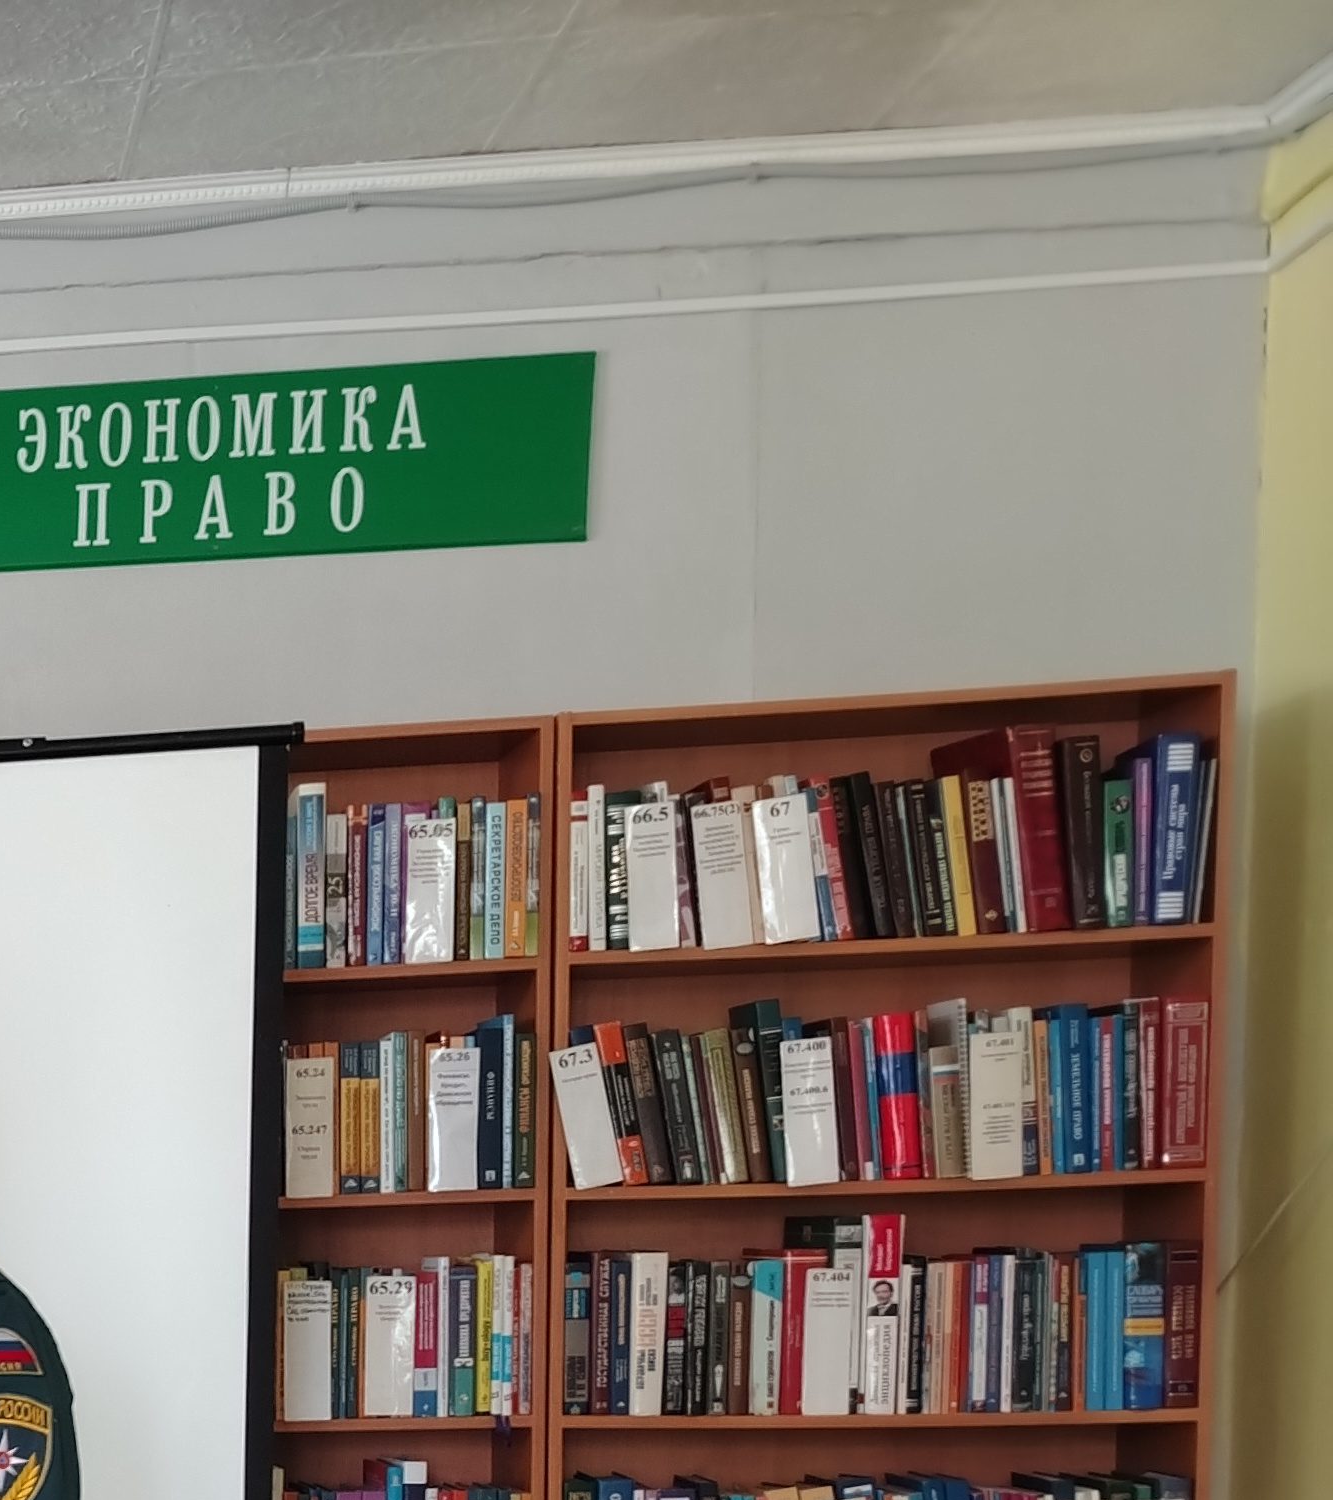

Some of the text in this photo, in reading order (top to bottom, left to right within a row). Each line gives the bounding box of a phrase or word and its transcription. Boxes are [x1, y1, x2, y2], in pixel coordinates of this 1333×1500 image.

[17, 383, 426, 473] ЭКОНОМИКА
[73, 466, 365, 547] ПРАВО
[409, 823, 453, 840] 65.05
[632, 806, 668, 825] 66.5
[769, 801, 790, 818] 67
[1162, 784, 1180, 879] Правовые системы
[1175, 804, 1189, 860] стран мира
[490, 815, 502, 946] СЕКРЕТАРСКОЕ ДЕЛО
[511, 813, 523, 902] ДЕЛОПРОИЗВОДСТВО
[305, 852, 319, 923] ДОЛГОЕ ВРЕМЯ
[329, 877, 344, 895] 25
[558, 1049, 592, 1070] 67.3
[786, 1040, 826, 1054] 67.400
[485, 1071, 495, 1120] ФИНАНСЫ
[1071, 1053, 1084, 1140] ЗЕМЕЛЬНОЕ ПРАВО
[369, 1281, 412, 1295] 65.29
[812, 1272, 850, 1282] 67.404
[351, 1286, 359, 1322] ПРАВО
[596, 1258, 611, 1388] ГОСУДАРСТВЕННАЯ СЛУЖБА
[880, 1324, 891, 1405] энциклопедия
